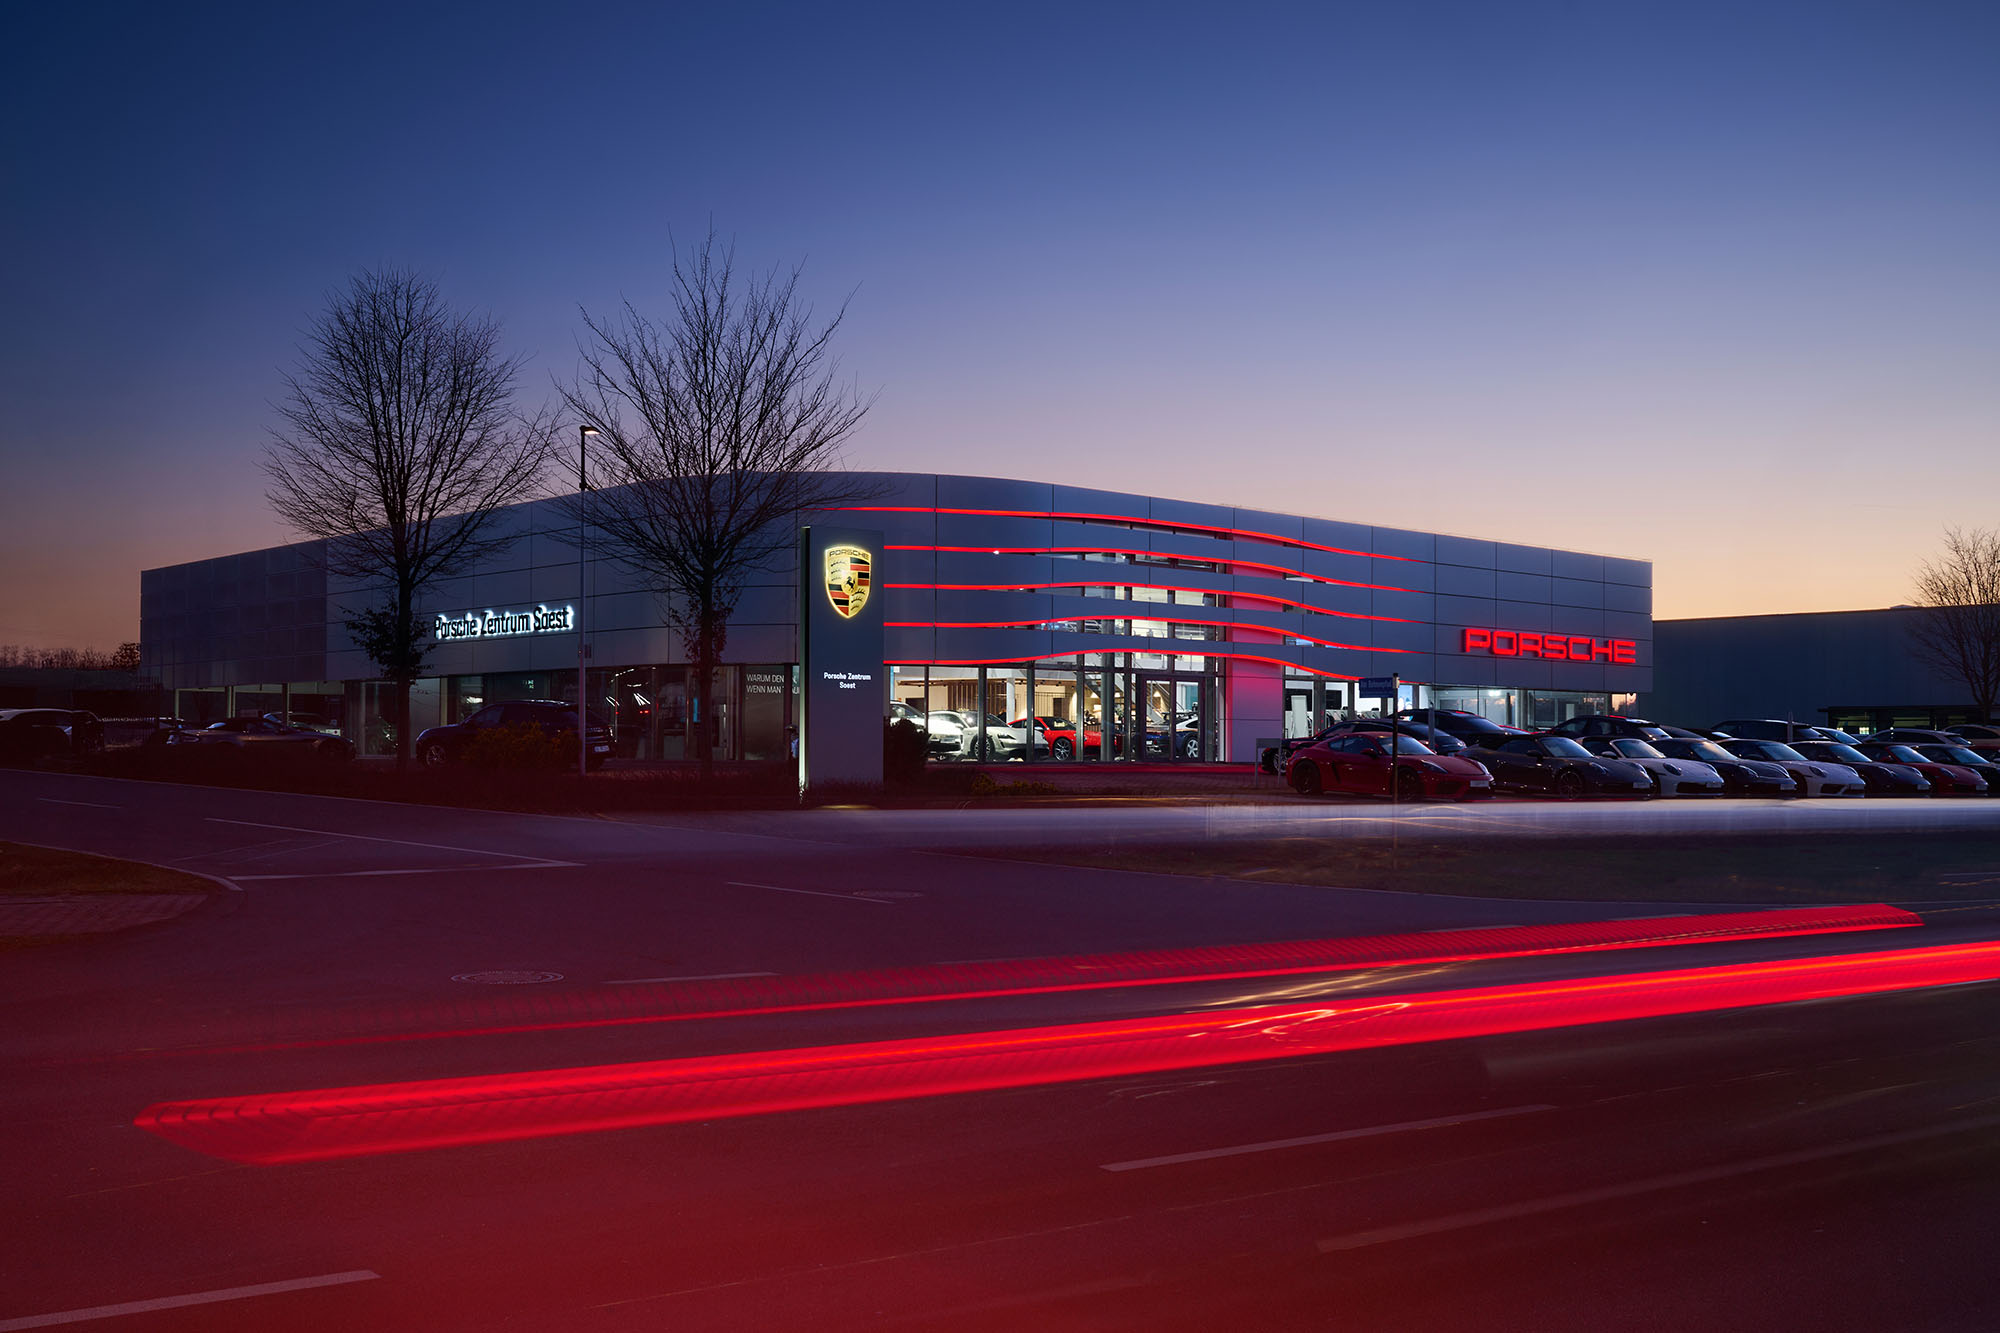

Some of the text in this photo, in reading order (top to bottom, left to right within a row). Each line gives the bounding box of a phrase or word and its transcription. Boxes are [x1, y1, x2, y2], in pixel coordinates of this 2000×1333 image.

[829, 549, 870, 560] PORSCHE
[433, 604, 573, 639] Porsche Zentrum Soest
[1464, 628, 1636, 663] PORSCHE
[746, 673, 771, 683] WARUM
[823, 672, 872, 681] Porsche Zentrum
[746, 685, 766, 693] WENN
[767, 685, 781, 694] MAN
[839, 681, 856, 689] Soest
